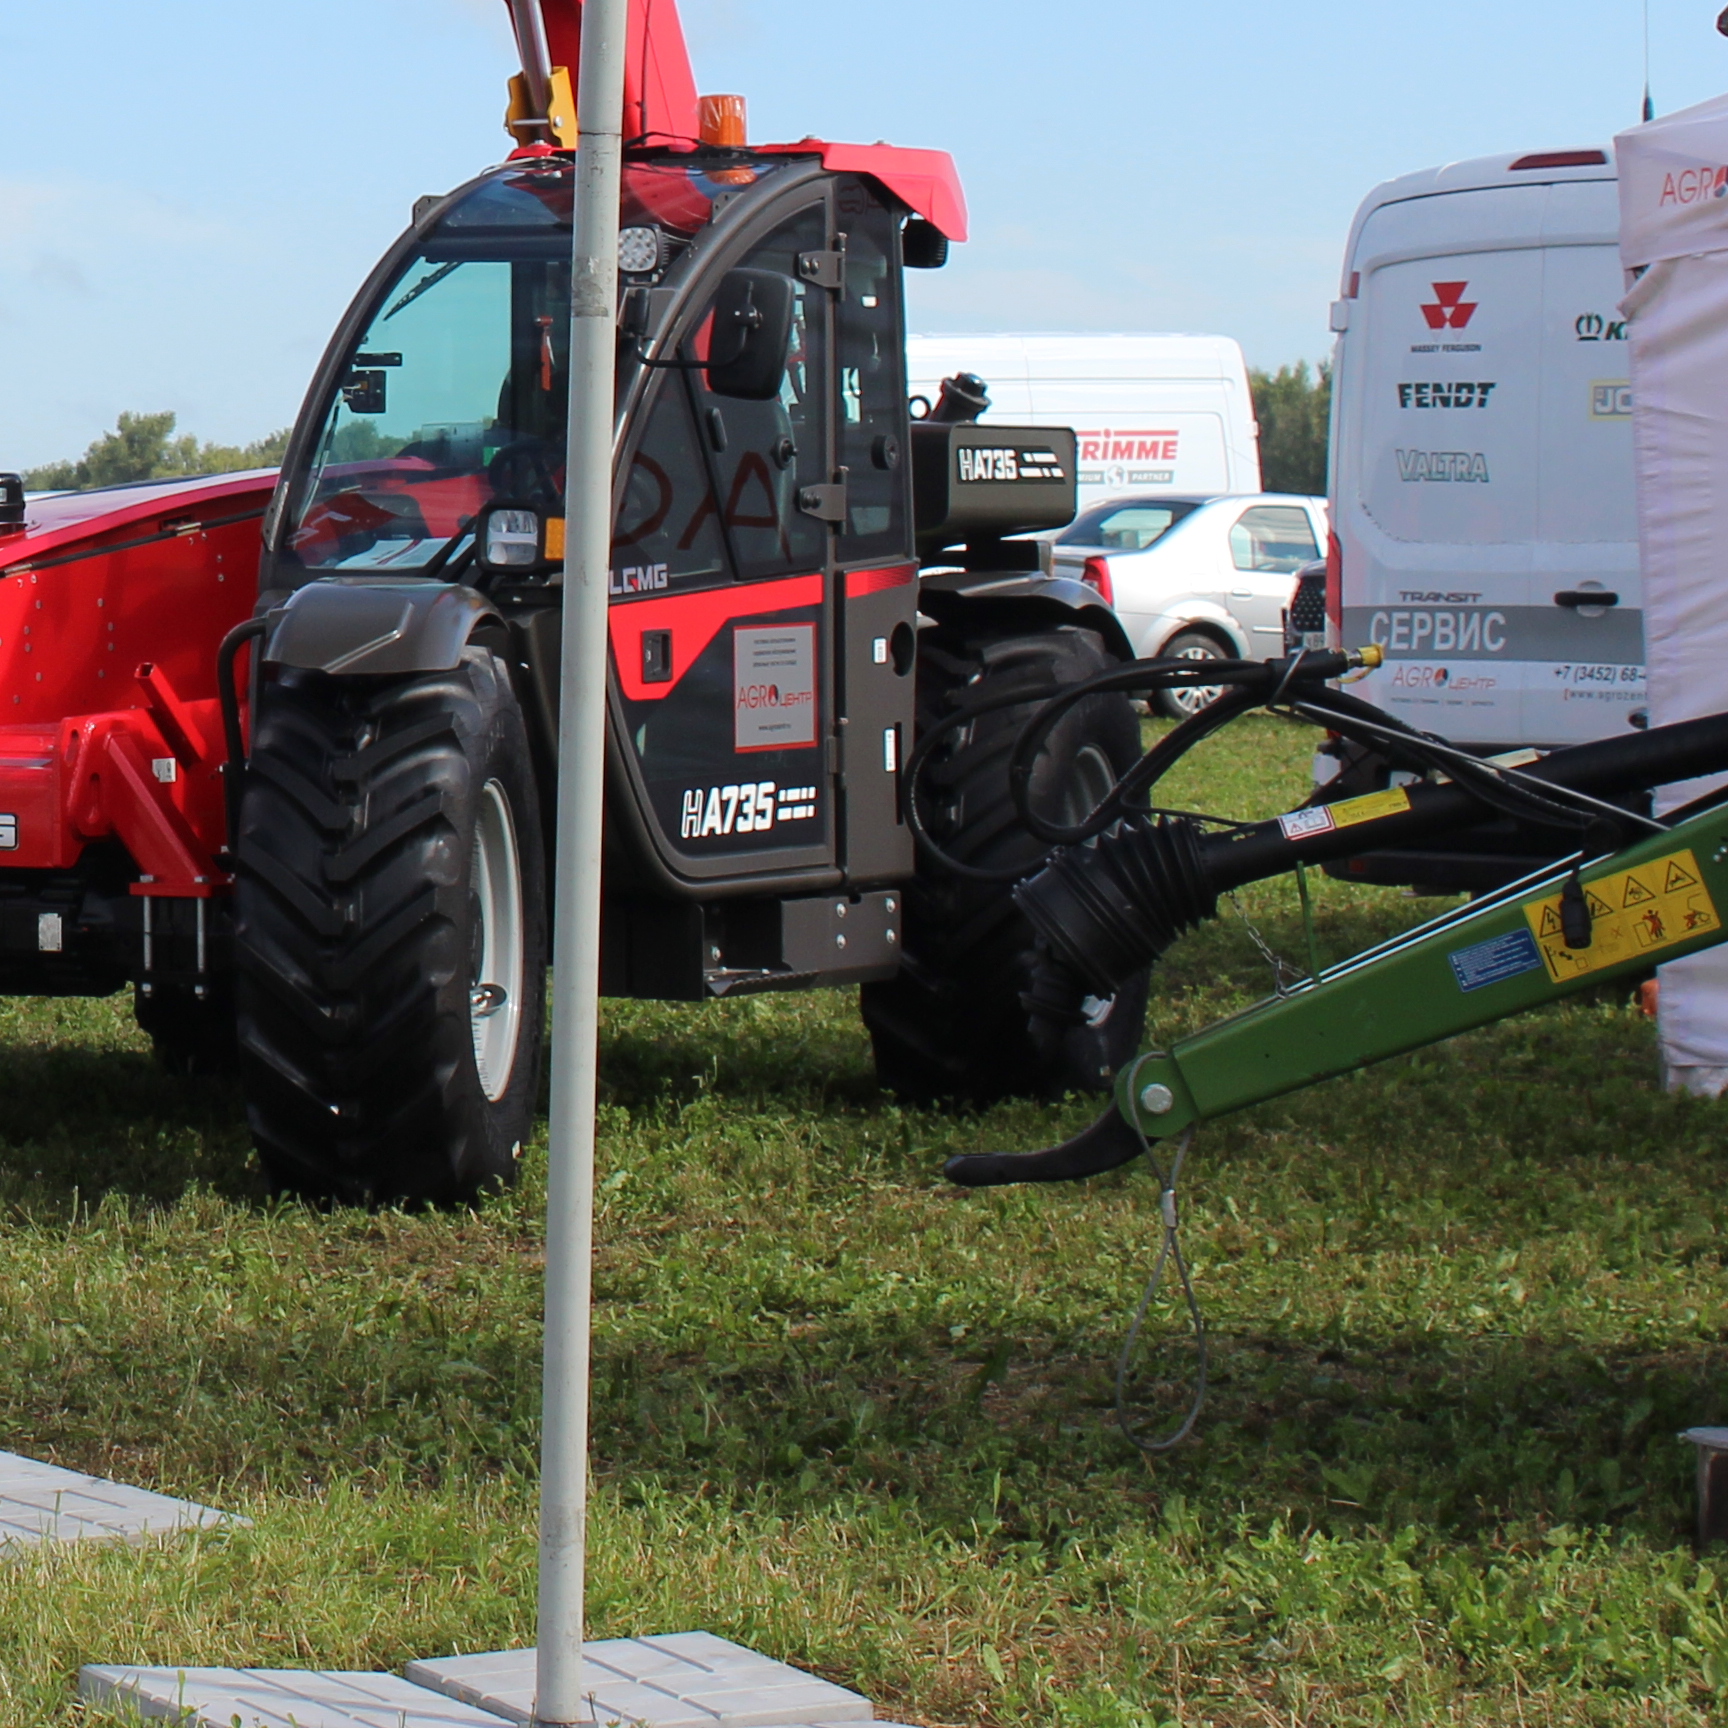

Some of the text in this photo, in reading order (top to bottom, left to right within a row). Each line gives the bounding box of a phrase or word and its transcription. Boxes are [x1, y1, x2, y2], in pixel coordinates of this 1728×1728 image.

[1411, 343, 1482, 353] MASSEY FERGUSON
[1397, 381, 1497, 409] FENDT
[1594, 388, 1633, 414] JC
[1078, 430, 1179, 461] RIMME
[958, 448, 1019, 482] HA735
[1395, 448, 1490, 483] VALTRA
[1399, 591, 1483, 603] TRANSIT
[1369, 611, 1507, 652] СЕРВИС
[1554, 665, 1647, 685] +7 (3452) 68-
[680, 780, 776, 840] HA735
